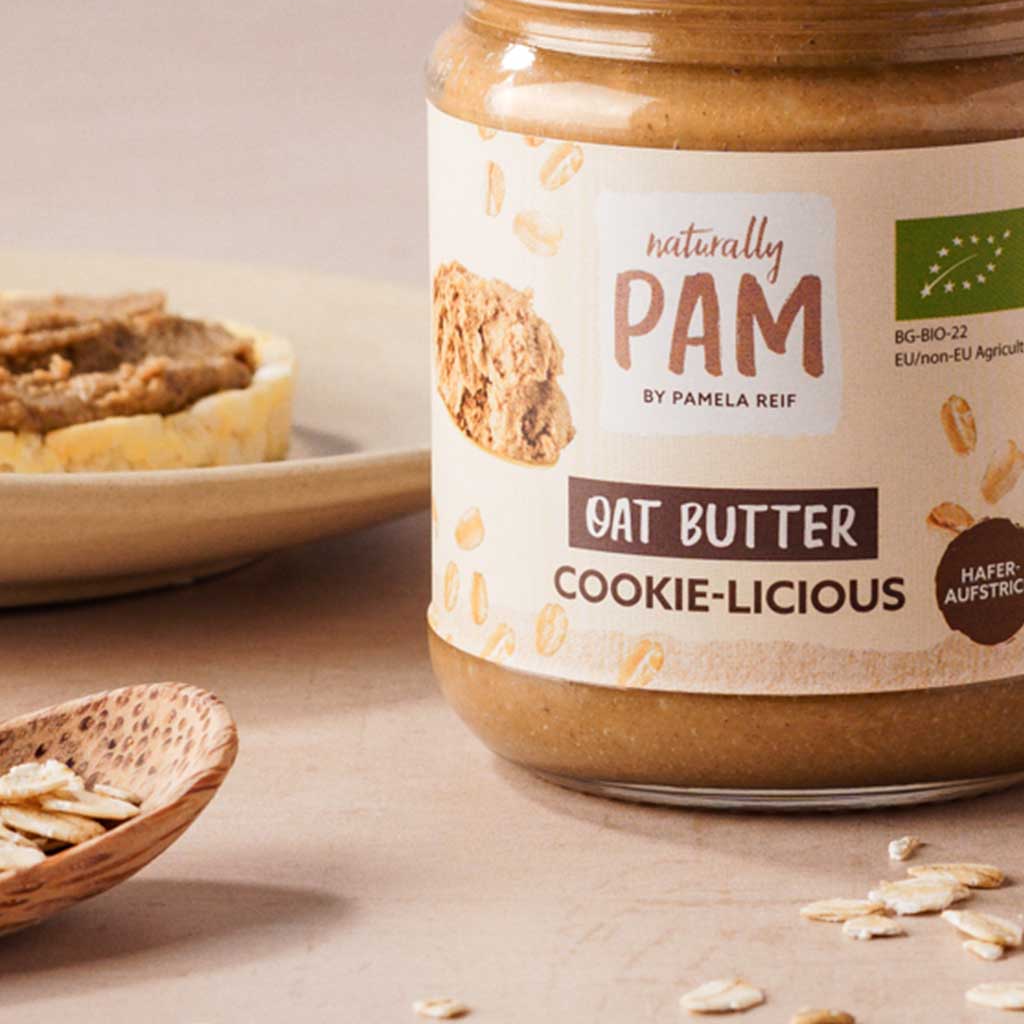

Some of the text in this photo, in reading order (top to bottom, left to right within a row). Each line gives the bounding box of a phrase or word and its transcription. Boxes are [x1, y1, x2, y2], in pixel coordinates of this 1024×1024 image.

[646, 216, 784, 284] naturally
[614, 270, 824, 378] PAM
[895, 325, 968, 344] BG-BIO-22
[895, 347, 972, 366] EU/non-EU
[643, 388, 797, 408] BY PAMELA REIF
[586, 495, 858, 550] OAT BUTTER
[554, 565, 906, 615] COOKIE-LICIOUS
[961, 561, 1020, 583] HAFER-
